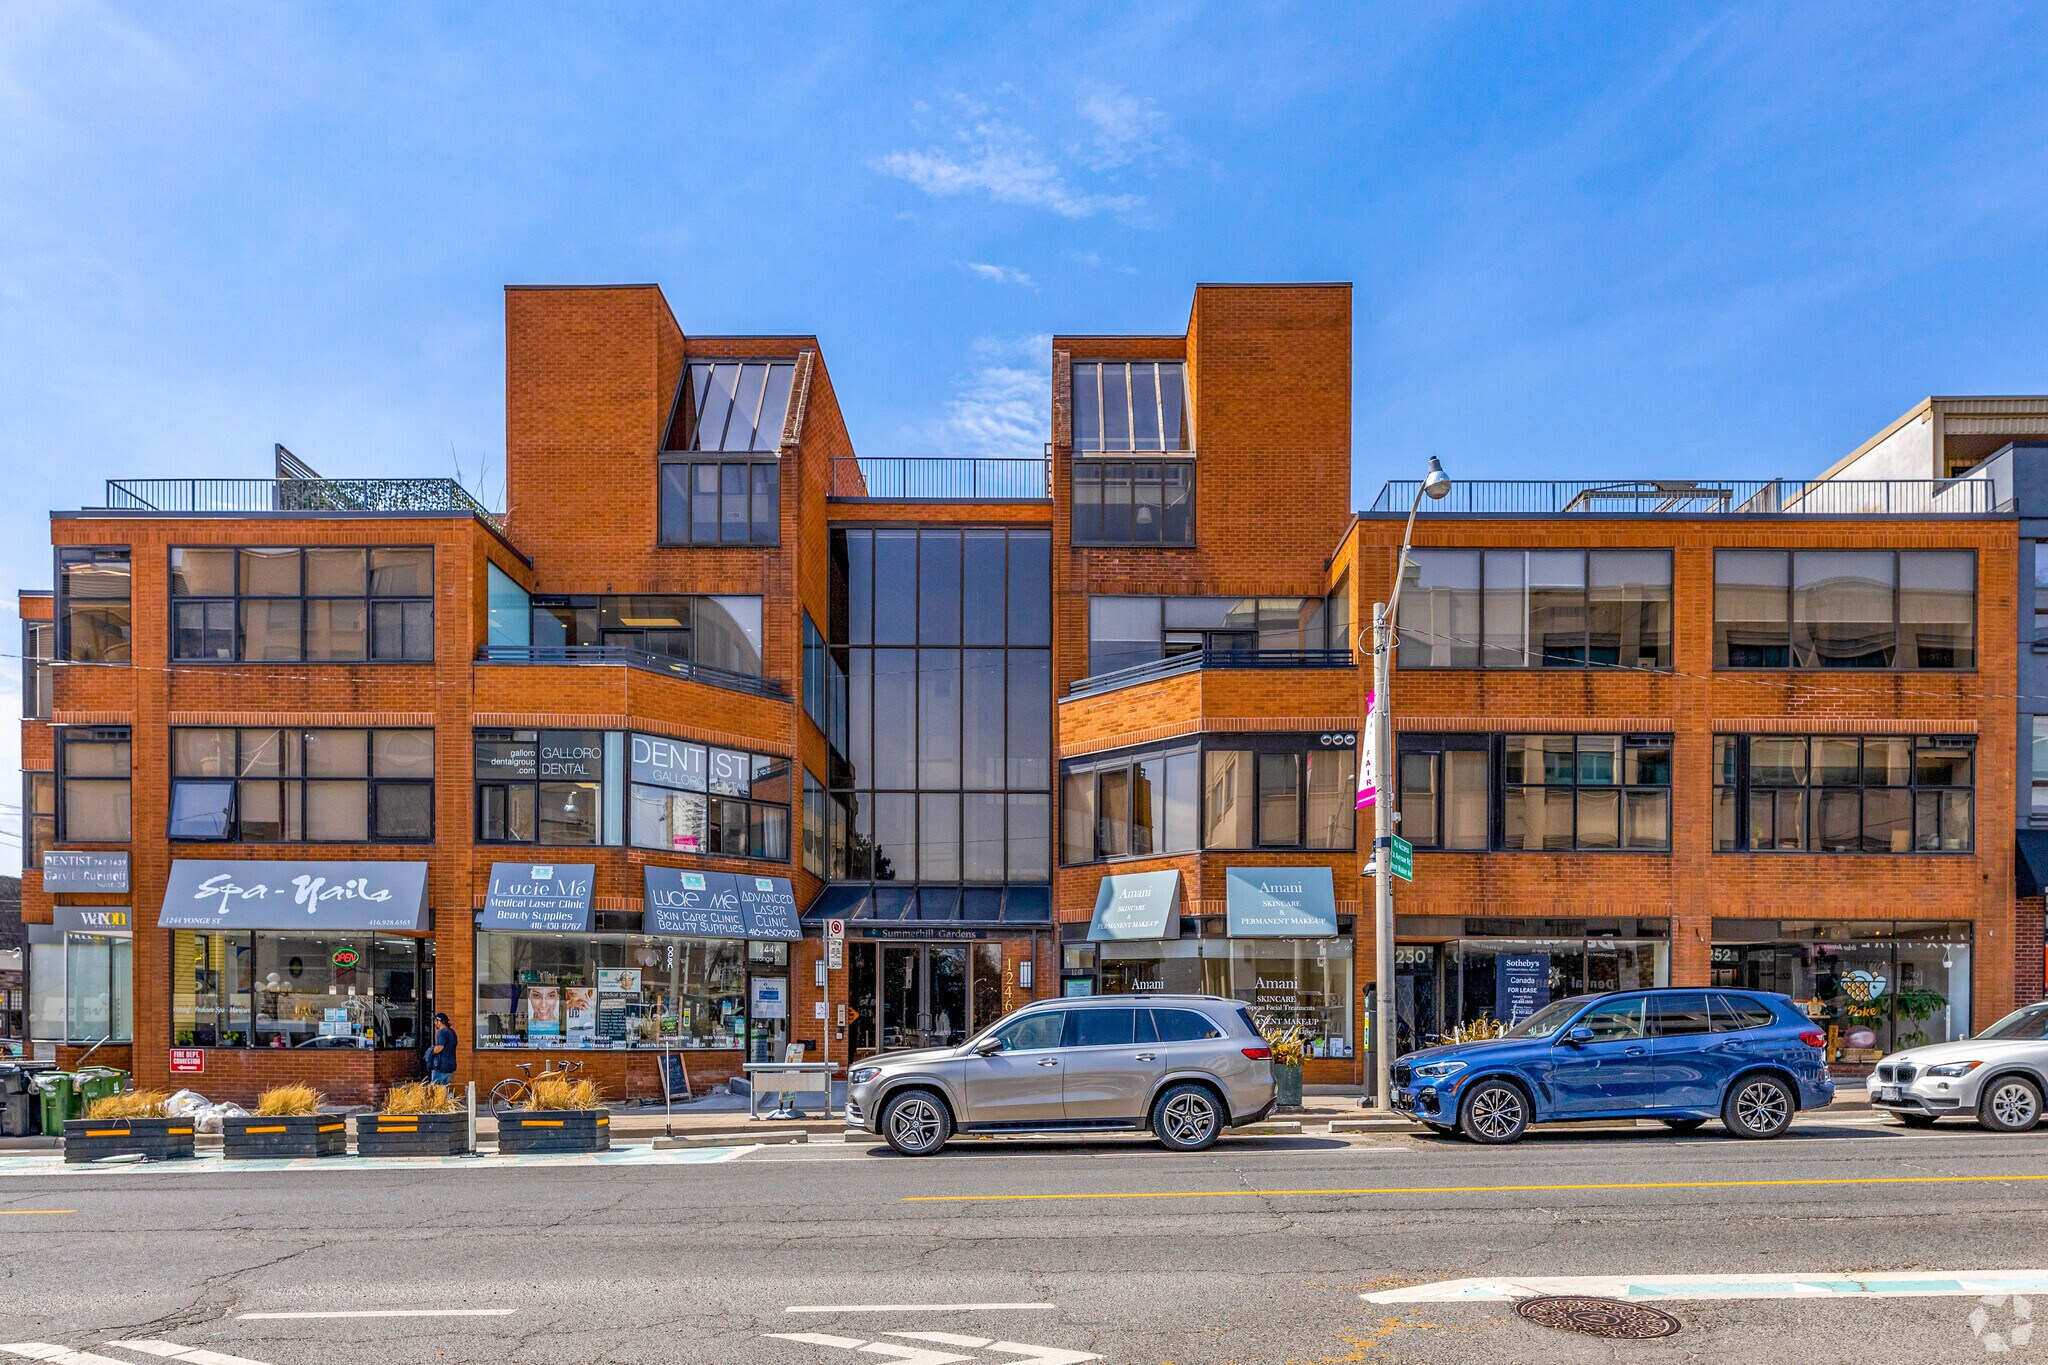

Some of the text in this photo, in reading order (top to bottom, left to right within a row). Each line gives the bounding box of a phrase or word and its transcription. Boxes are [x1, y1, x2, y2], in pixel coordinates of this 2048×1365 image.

[510, 749, 536, 758] galloro
[542, 747, 601, 759] GALLORO
[491, 758, 536, 766] dentalgroup
[632, 738, 748, 780] DENTIST
[542, 763, 589, 775] DENTAL
[653, 769, 749, 795] GALLORO DENTAL
[44, 856, 92, 866] DENTIST
[493, 878, 586, 897] Lucie Mé
[1119, 885, 1153, 899] Amani
[1259, 881, 1303, 893] Amani
[193, 873, 268, 915] Spa
[292, 874, 393, 915] Nails
[741, 890, 793, 905] ADVANCED
[489, 898, 585, 909] Medical Laser Clinic
[1117, 904, 1146, 913] SKINCARE
[752, 903, 787, 916] LASER
[183, 917, 209, 925] YONGE
[210, 917, 222, 925] ST
[497, 910, 573, 921] Beauty Supplies
[656, 909, 740, 924] SKIN CARE CLINIC
[1241, 917, 1326, 925] PERMANENT MAKE-UP
[529, 922, 582, 931] 416-450-9767
[755, 915, 789, 928] CLINIC
[1097, 920, 1159, 930] PERMANENT MAKE-UP
[658, 920, 745, 935] BEAUTY SUPPLIES
[882, 928, 977, 939] Summerhill Gardens
[755, 943, 781, 954] 1244A
[334, 953, 357, 963] OPEN
[755, 955, 774, 963] Yonge
[1506, 959, 1540, 969] Sotheby's
[1004, 958, 1014, 1012] 1246
[1131, 976, 1164, 990] Amani
[1254, 976, 1298, 989] Amani
[1510, 976, 1535, 984] Canada
[1256, 995, 1297, 1003] SKINCARE
[1847, 1004, 1877, 1017] Poke
